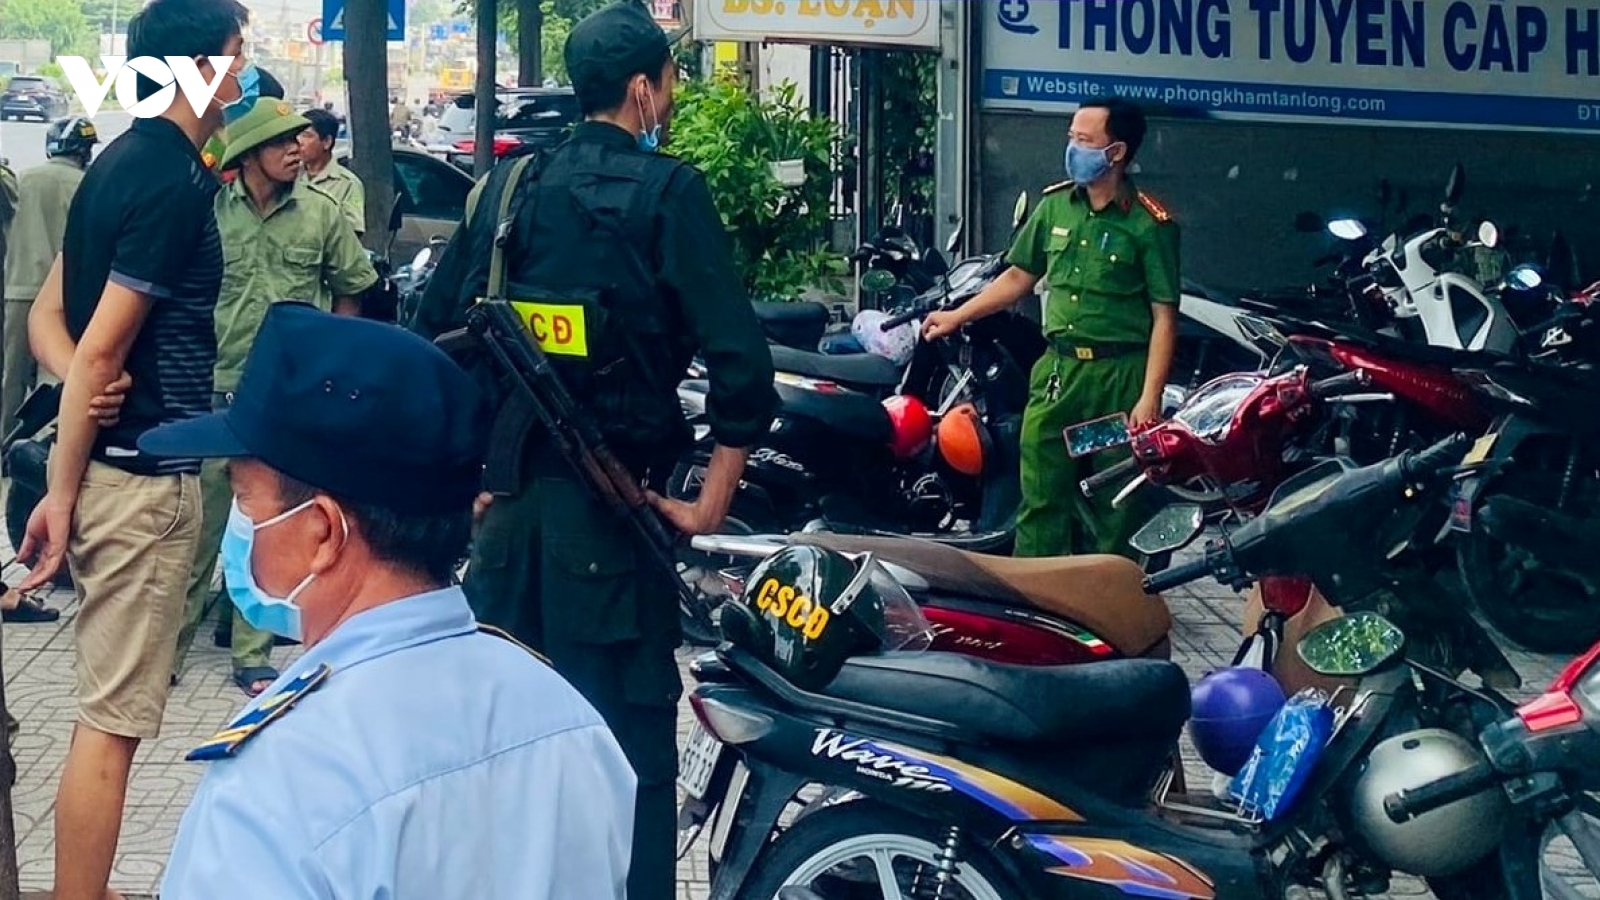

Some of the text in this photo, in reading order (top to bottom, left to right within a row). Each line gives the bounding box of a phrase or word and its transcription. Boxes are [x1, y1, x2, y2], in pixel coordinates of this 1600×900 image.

[1027, 76, 1106, 96] Website:
[1113, 83, 1386, 113] www.phongkhamtanlong.com
[811, 728, 948, 782] Wave
[856, 766, 893, 781] HONDA
